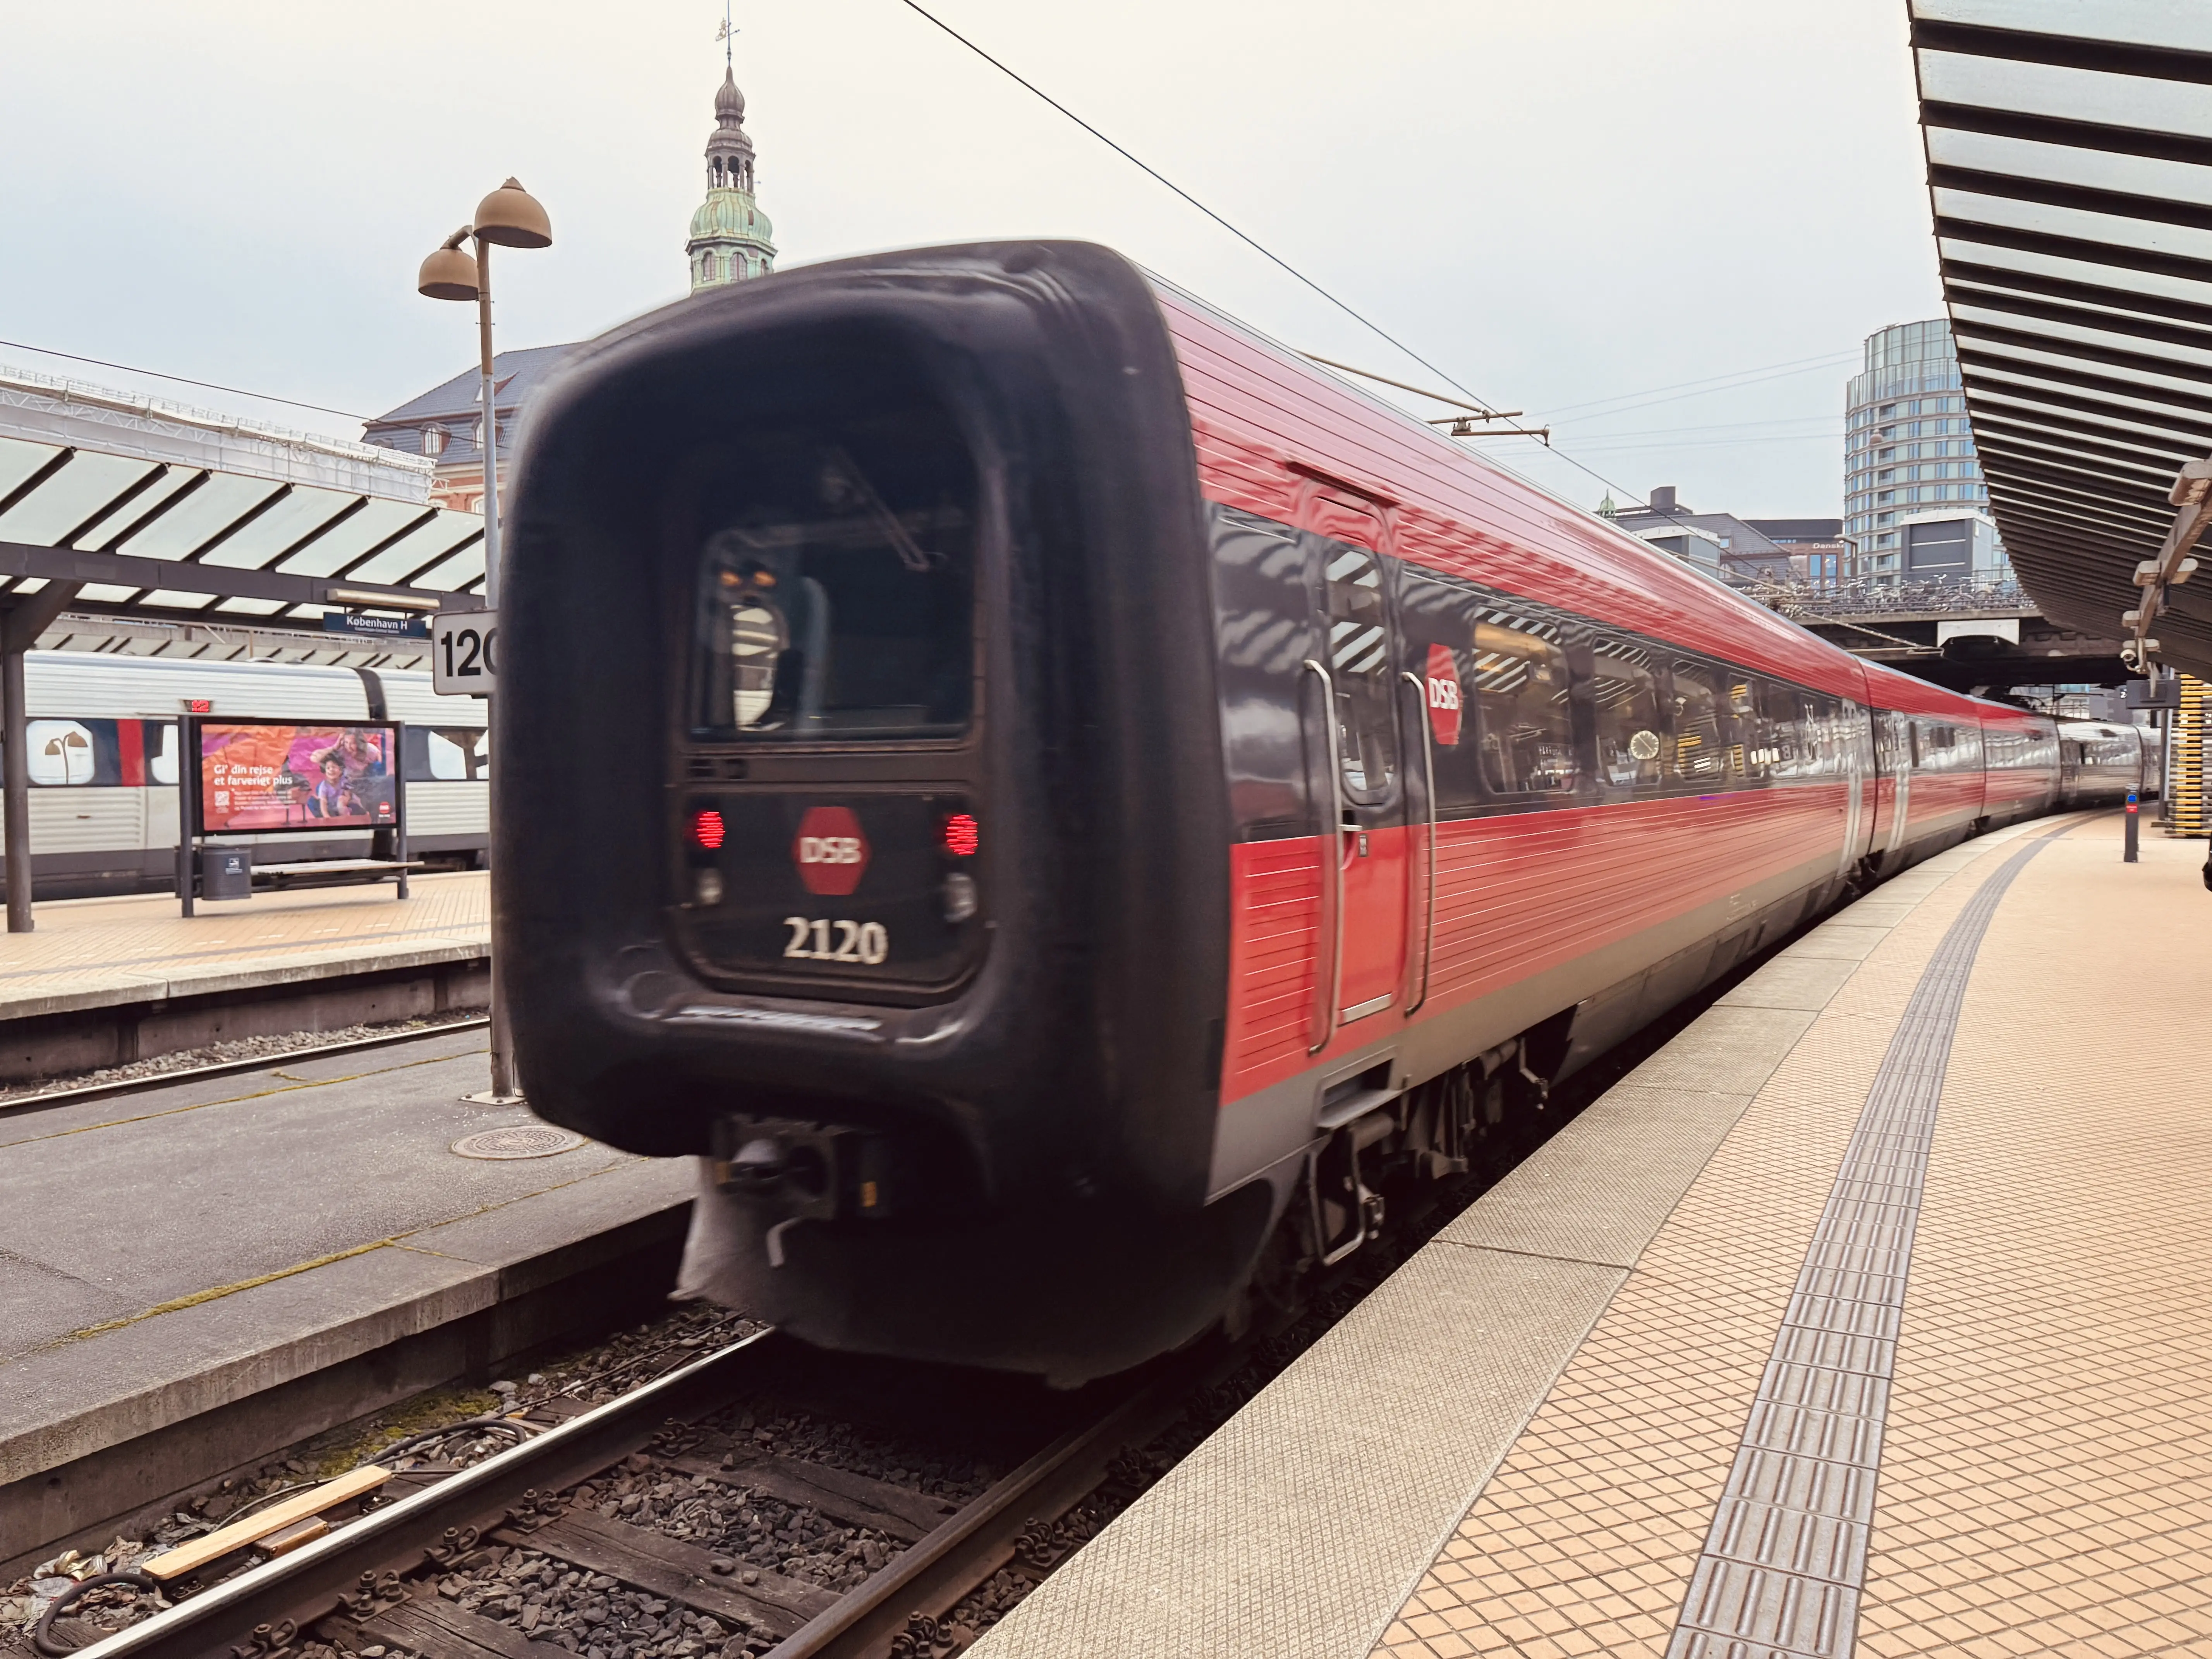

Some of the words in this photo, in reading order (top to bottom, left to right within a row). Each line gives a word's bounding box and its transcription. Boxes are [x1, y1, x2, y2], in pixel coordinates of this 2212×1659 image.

[347, 616, 398, 629] København
[400, 621, 407, 630] H
[1428, 677, 1458, 709] DSB
[231, 765, 247, 774] din
[250, 765, 273, 775] rejse
[228, 775, 271, 786] farverigt
[273, 775, 292, 786] plus
[800, 837, 862, 864] DSB
[783, 917, 888, 964] 2120
